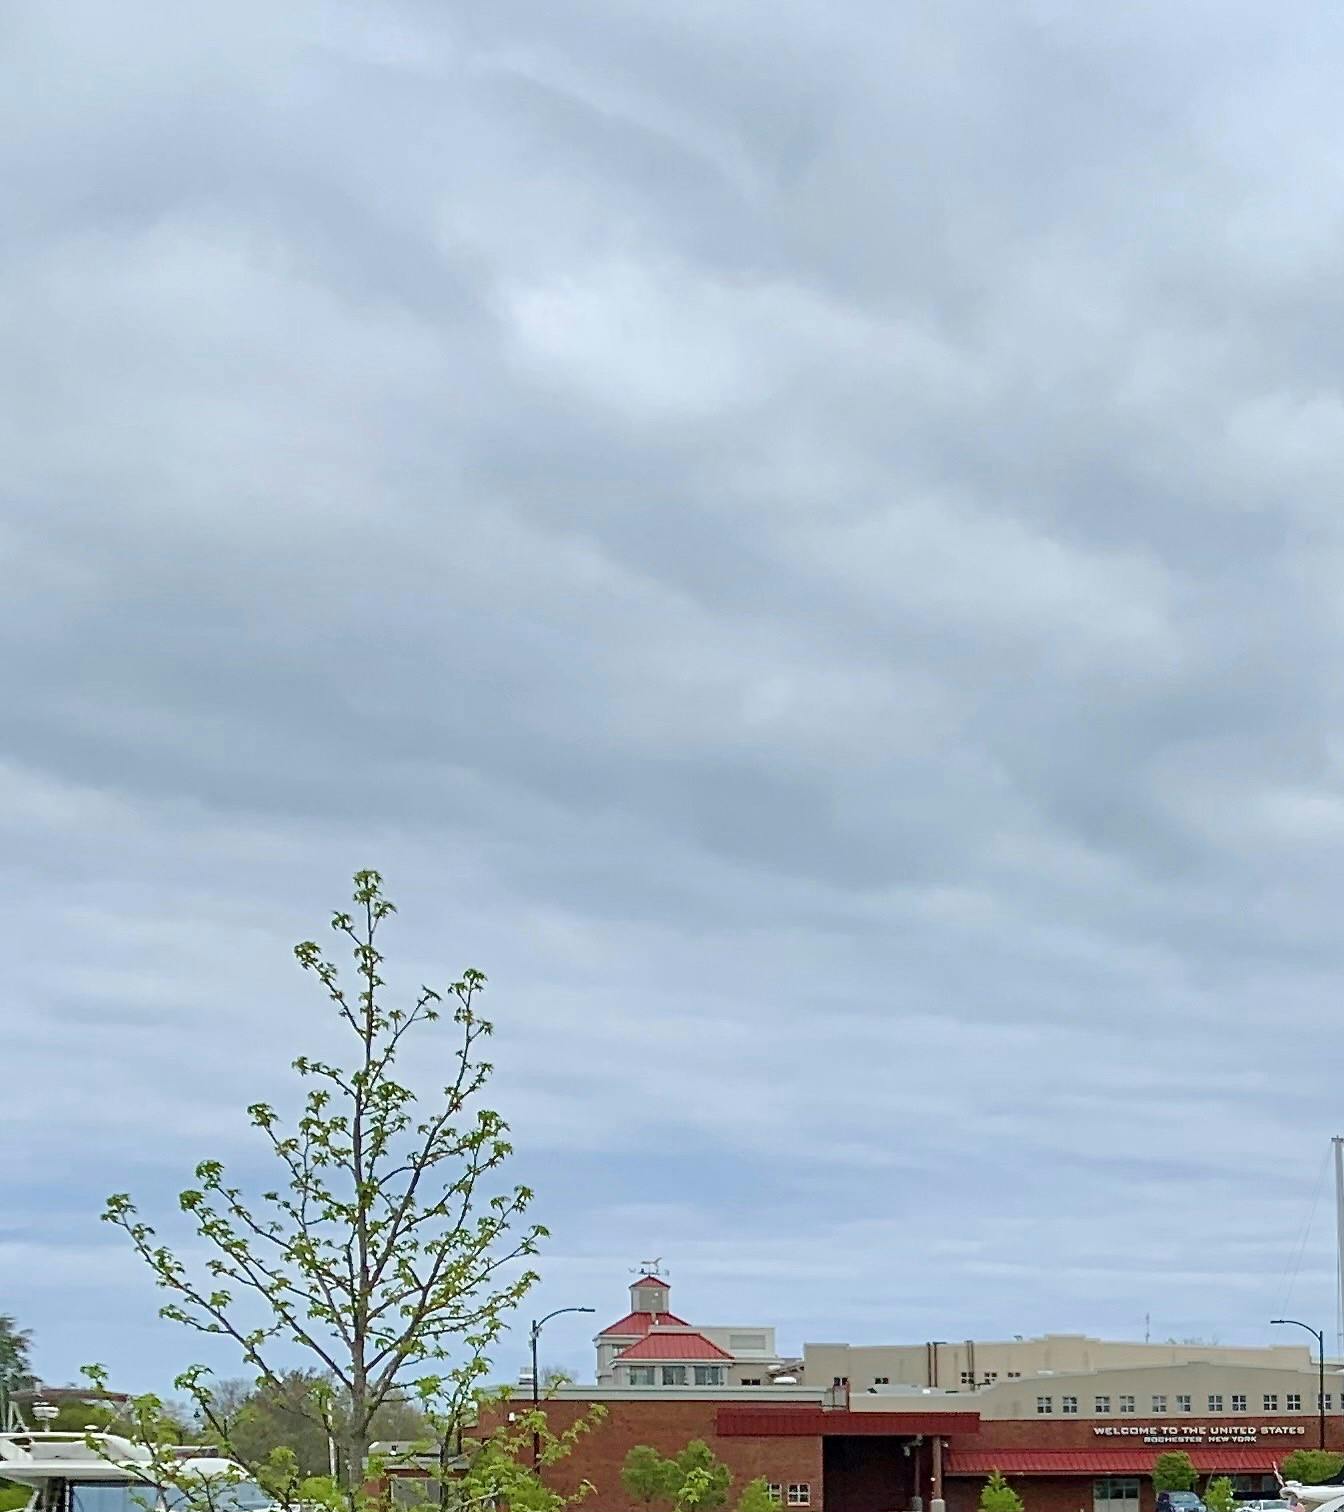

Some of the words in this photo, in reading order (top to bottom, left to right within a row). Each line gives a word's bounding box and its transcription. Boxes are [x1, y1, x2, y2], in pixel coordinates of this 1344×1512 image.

[1093, 1426, 1157, 1436] WELCOME
[1162, 1426, 1178, 1435] TO
[1181, 1426, 1207, 1435] THE
[1210, 1426, 1257, 1435] UNITED
[1260, 1426, 1305, 1435] STATES
